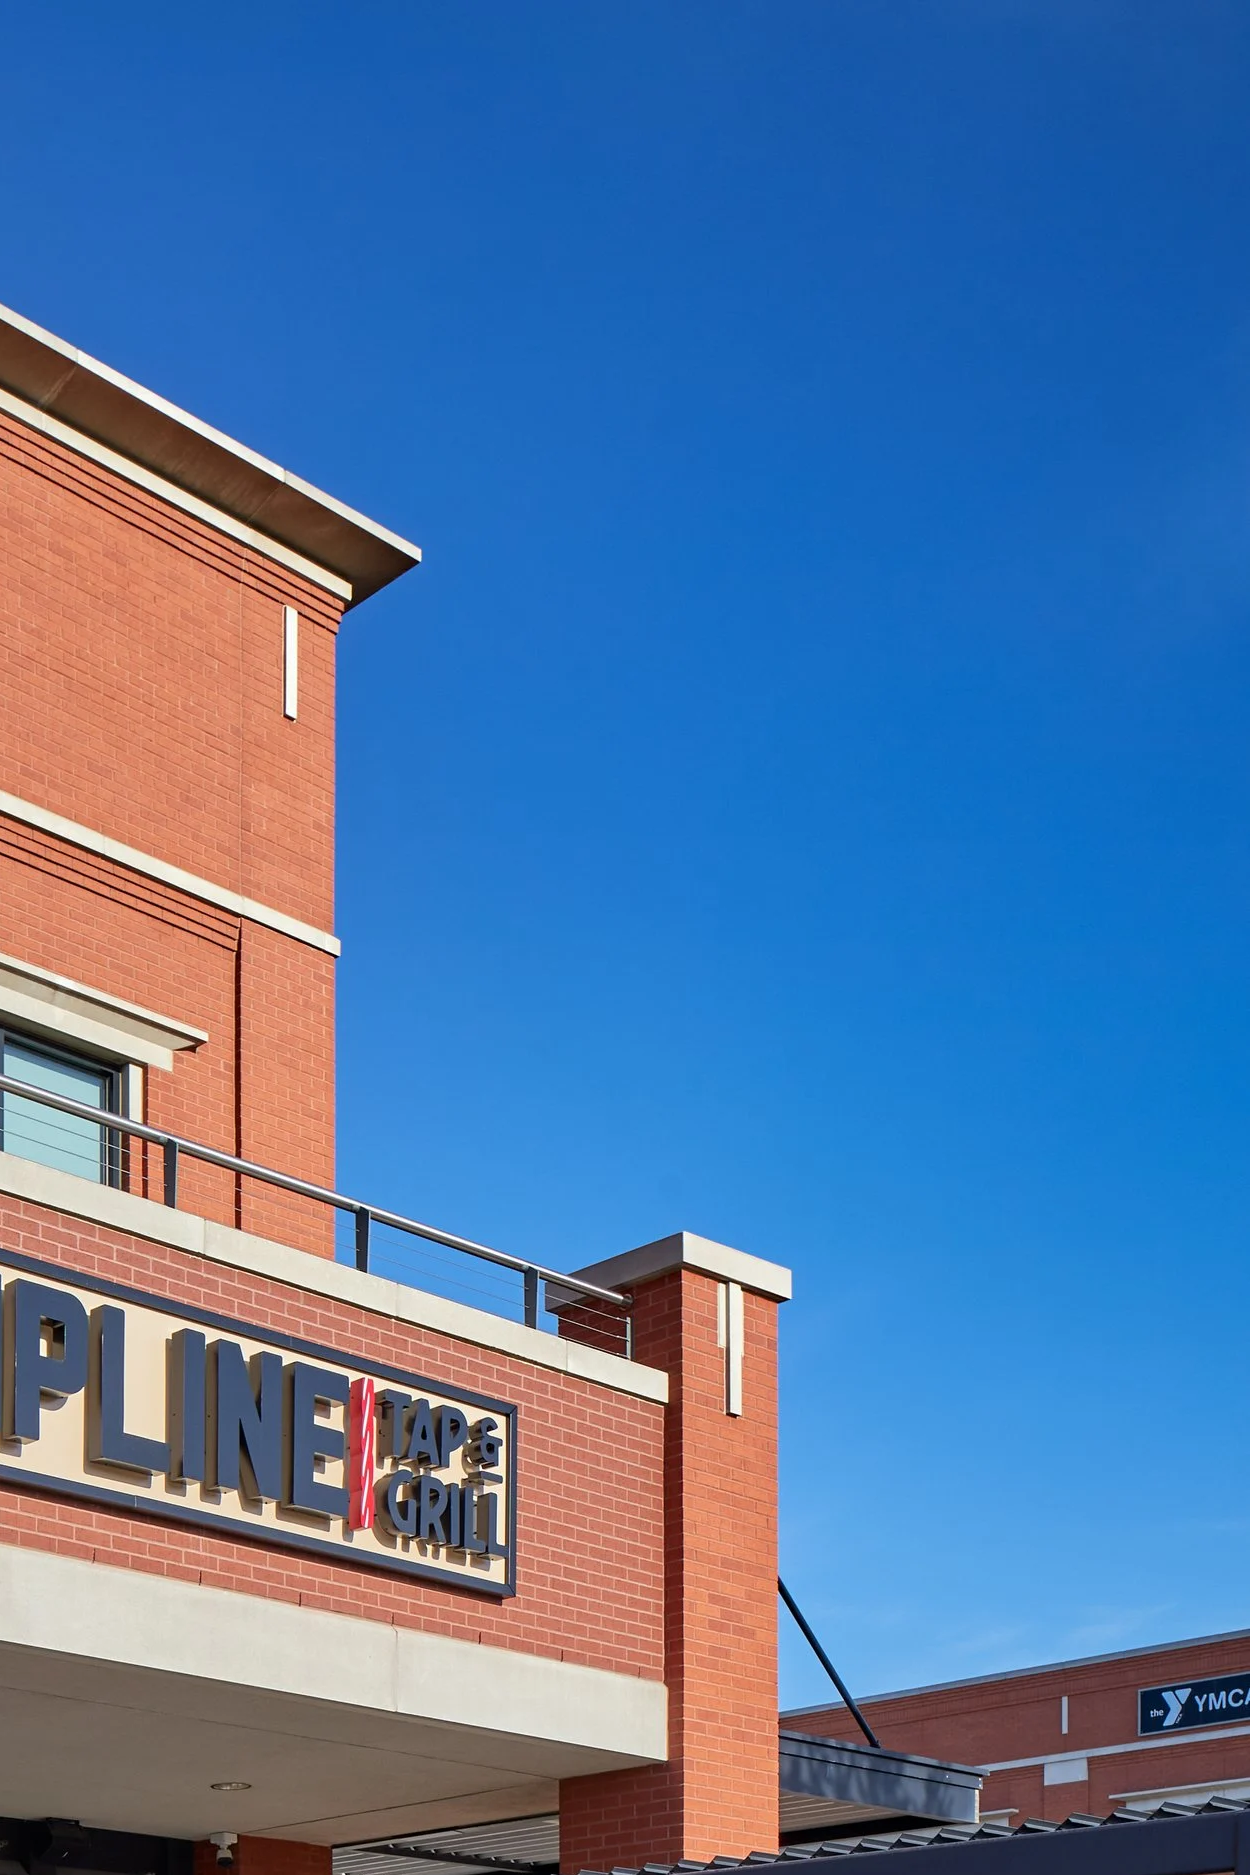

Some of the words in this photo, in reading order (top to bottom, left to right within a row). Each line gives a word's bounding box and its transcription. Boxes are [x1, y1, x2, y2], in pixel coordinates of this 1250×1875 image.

[375, 1389, 468, 1470] TAP
[470, 1417, 504, 1472] &
[375, 1470, 510, 1560] GRILL
[1150, 1709, 1164, 1718] the
